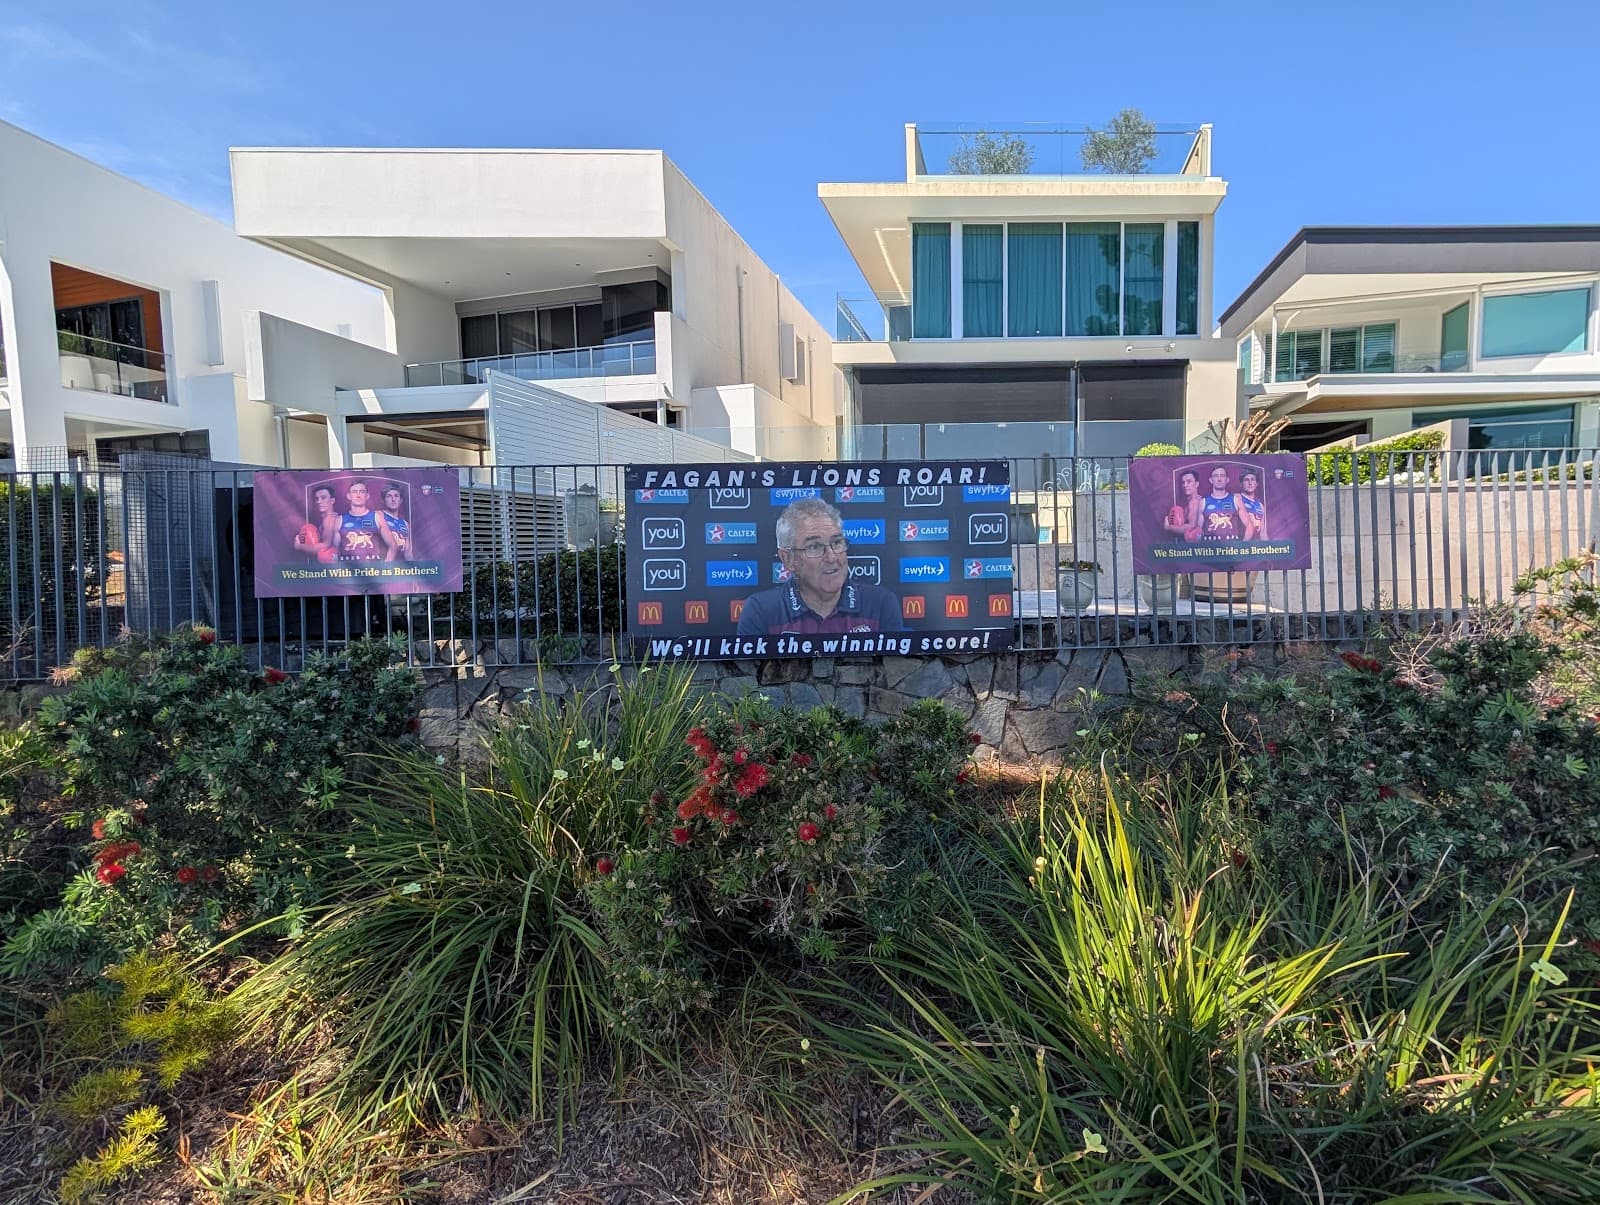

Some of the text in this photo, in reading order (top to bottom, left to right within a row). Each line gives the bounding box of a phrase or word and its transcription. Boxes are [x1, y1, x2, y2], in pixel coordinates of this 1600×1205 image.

[644, 467, 987, 488] FAGAN'S LIONS ROAR!
[658, 488, 688, 497] CALTEX
[856, 488, 884, 496] CALTEX
[648, 523, 679, 544] youi
[727, 529, 756, 537] CALTEX
[920, 527, 948, 535] CALTEX
[974, 518, 1003, 539] youi
[1153, 549, 1168, 558] We
[1168, 549, 1193, 558] Stand
[1194, 548, 1214, 557] With
[1216, 547, 1239, 556] Pride
[1251, 545, 1291, 555] Brothers!
[281, 570, 297, 579] We
[299, 568, 327, 578] Stand
[328, 567, 352, 577] With
[354, 567, 380, 577] Pride
[394, 566, 439, 576] Brothers!
[649, 564, 680, 584] youi
[711, 566, 745, 580] swyftx
[848, 561, 876, 580] youi
[904, 564, 936, 577] swyftx
[985, 564, 1013, 572] CALTEX
[651, 632, 990, 657] We'll kick the winning score!
